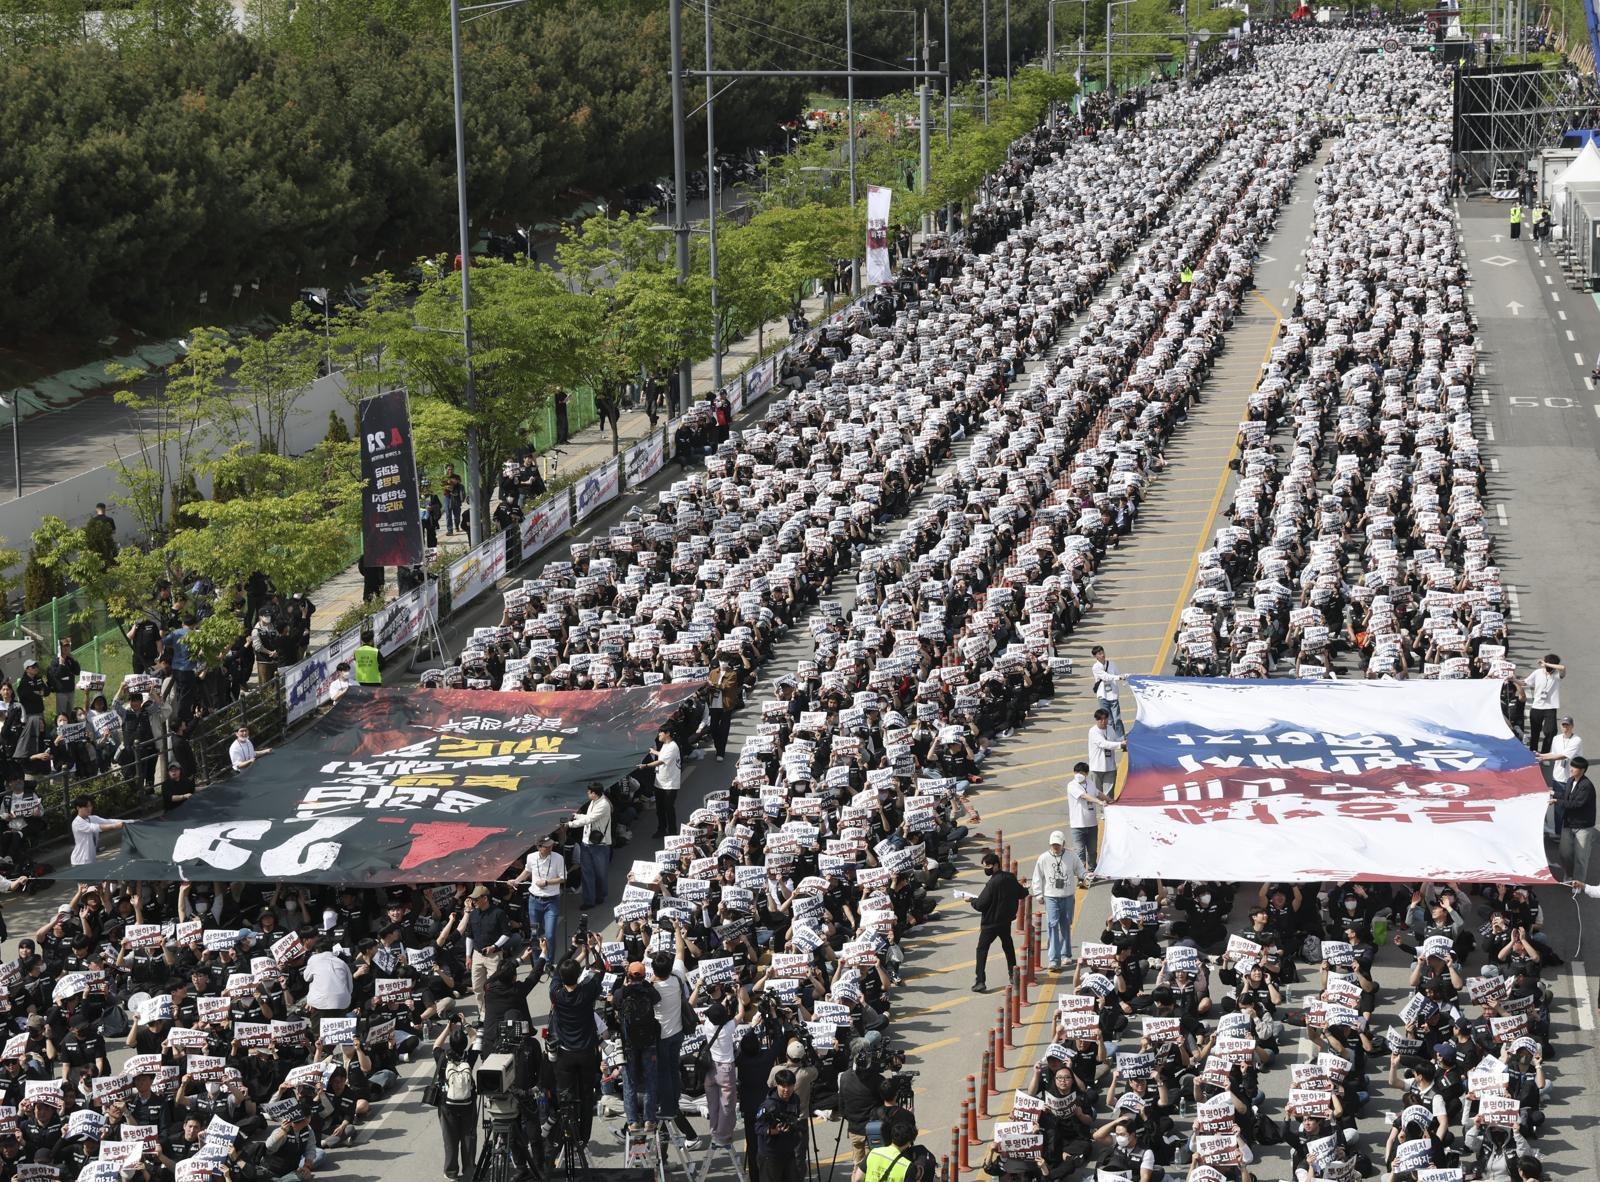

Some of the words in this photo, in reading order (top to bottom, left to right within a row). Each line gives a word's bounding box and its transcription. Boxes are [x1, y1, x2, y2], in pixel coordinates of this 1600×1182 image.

[1179, 752, 1489, 777] 상한폐지
[295, 785, 492, 819] 성과급
[907, 797, 930, 807] 투명하게
[907, 811, 930, 822] 상한폐지
[1163, 800, 1497, 825] 투명하게
[769, 835, 795, 844] 투명하게
[172, 816, 508, 877] 4.23
[828, 842, 854, 851] 투명하게
[768, 855, 791, 865] 투명하게
[883, 851, 906, 867] 상한폐지
[737, 868, 763, 878] 상한폐지
[859, 869, 886, 880] 투명하게
[679, 880, 706, 890] 상한폐지
[626, 887, 650, 899] 상한폐지
[663, 899, 689, 908] 상한폐지
[795, 896, 820, 912] 상한폐지
[128, 926, 156, 938] 투명하게
[206, 931, 235, 940] 상한폐지
[274, 933, 294, 956] 투명하게
[1230, 940, 1258, 951] 투명하게
[1167, 948, 1197, 961] 상한폐지
[1325, 945, 1350, 956] 상한폐지
[702, 959, 730, 972] 상한폐지
[774, 956, 804, 964] 투명하게
[705, 971, 732, 984] 실현하자
[378, 981, 407, 991] 투명하게
[1471, 978, 1500, 994] 투명하게
[381, 992, 410, 1002] 바꾸고!!!
[1061, 998, 1090, 1007] 투명하게
[1504, 998, 1532, 1011] 투명하게
[323, 1020, 352, 1032] 상한폐지
[1064, 1016, 1095, 1025] 투명하게
[1146, 1020, 1175, 1030] 투명하게
[1494, 1015, 1523, 1030] 투명하게
[238, 1026, 268, 1036] 투명하게
[273, 1023, 303, 1033] 투명하게
[1067, 1028, 1096, 1038] 바꾸고!!!
[324, 1033, 354, 1044] 실현하자
[1150, 1032, 1179, 1041] 바꾸고!!!
[1219, 1041, 1251, 1050] 투명하게
[190, 1058, 220, 1069] 투명하게
[1119, 1055, 1150, 1066] 상한폐지
[193, 1072, 223, 1081] 바꾸고!!!
[1122, 1067, 1153, 1078] 실현하자
[1295, 1068, 1324, 1077] 투명하게
[96, 1077, 129, 1091] 투명하게
[101, 1088, 132, 1104] 바꾸고!!!
[1292, 1092, 1327, 1102] 투명하게
[1482, 1100, 1515, 1110] 투명하게
[1200, 1106, 1230, 1118] 투명하게
[1203, 1121, 1234, 1131] 바꾸고!!!
[123, 1127, 153, 1139] 투명하게
[1005, 1136, 1038, 1148] 투명하게
[1200, 1137, 1232, 1151] 투명하게
[1009, 1151, 1041, 1159] 바꾸고!!!
[21, 1167, 55, 1176] 투명하게
